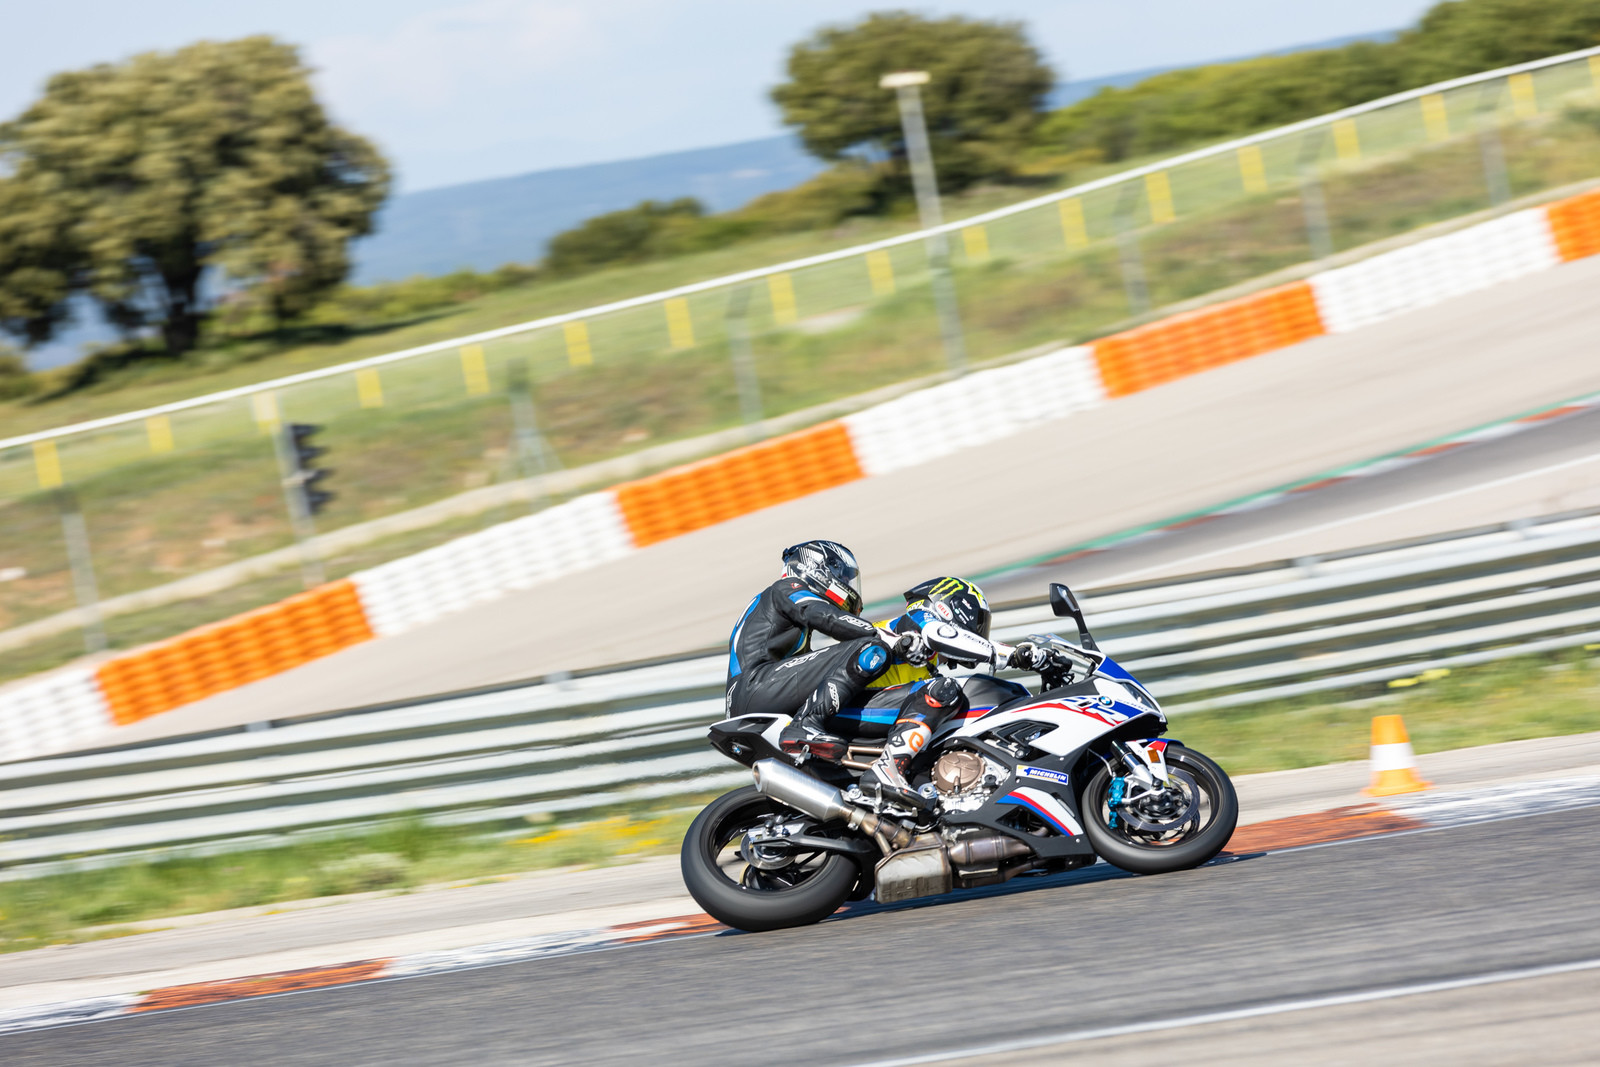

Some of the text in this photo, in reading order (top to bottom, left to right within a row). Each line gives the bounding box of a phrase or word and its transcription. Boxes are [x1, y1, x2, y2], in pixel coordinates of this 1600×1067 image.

[796, 561, 828, 583] SHARK
[937, 603, 950, 617] BELL
[1029, 768, 1067, 782] MICHELIN
